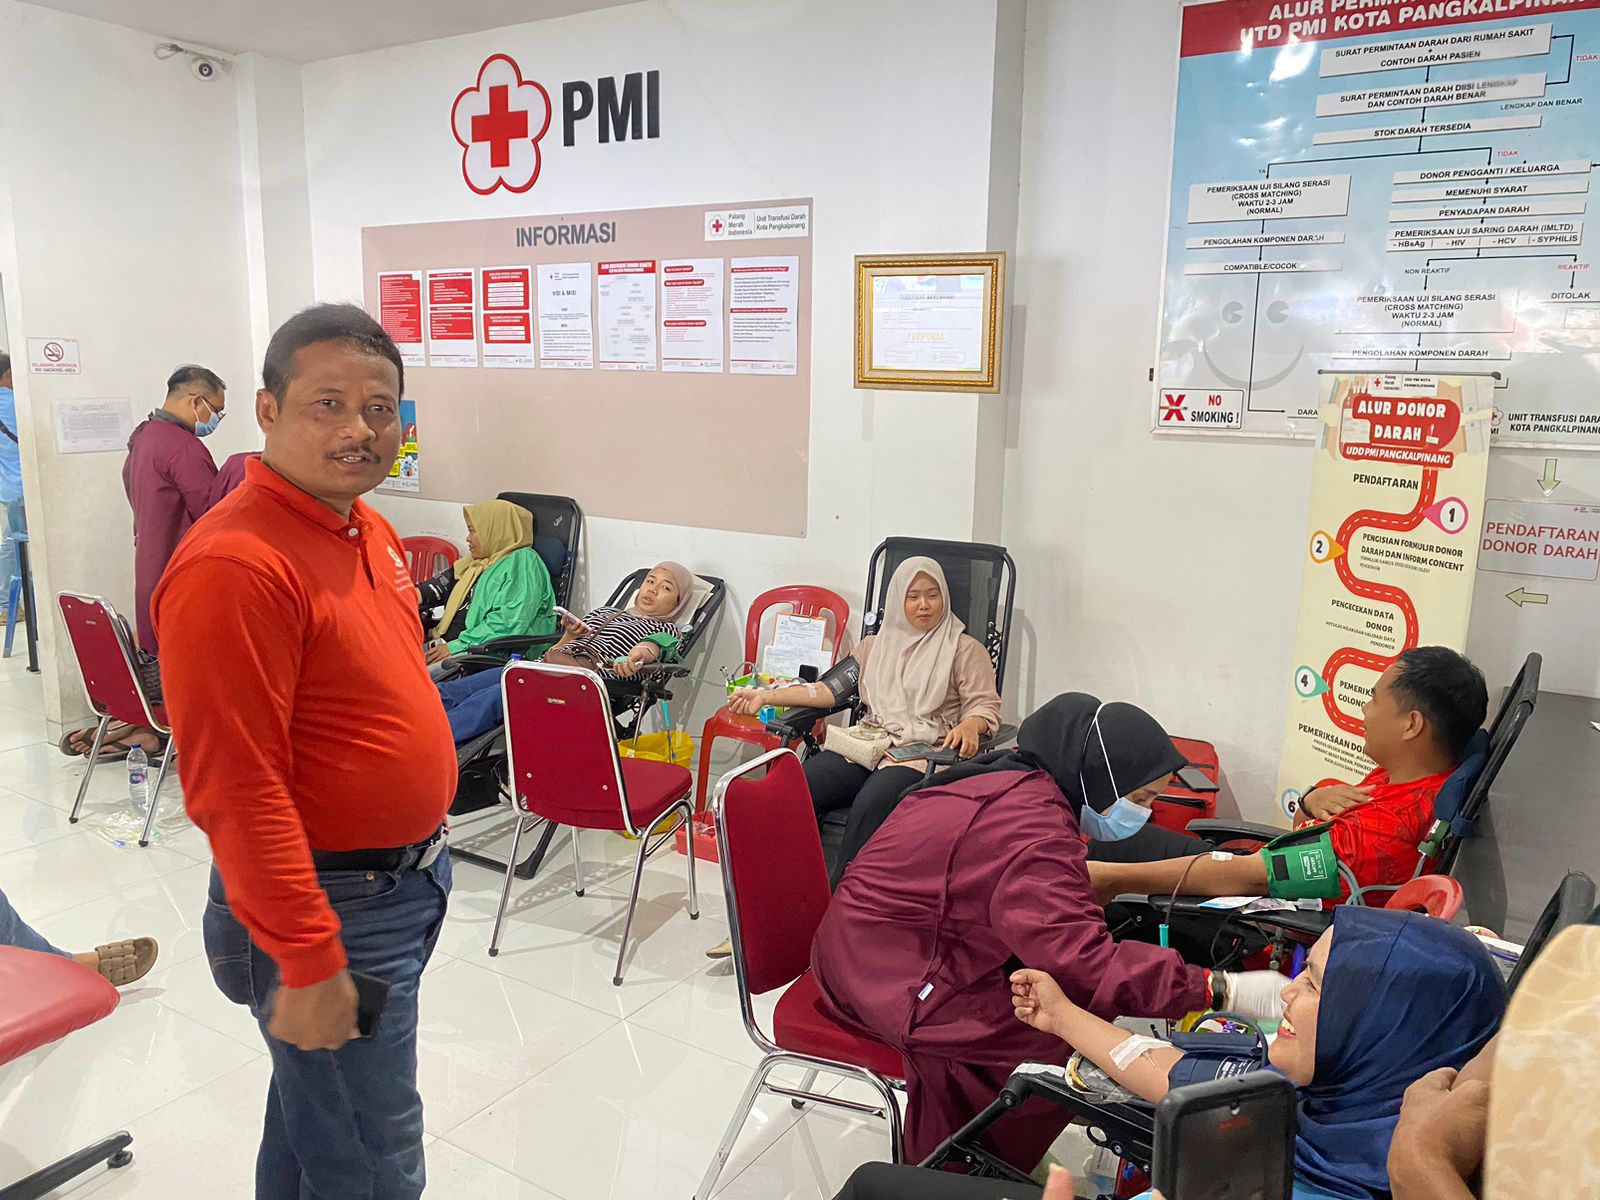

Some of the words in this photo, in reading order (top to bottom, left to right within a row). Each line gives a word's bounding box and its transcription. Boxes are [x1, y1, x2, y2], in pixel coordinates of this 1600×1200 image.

[1269, 0, 1324, 21] ALUR
[1288, 18, 1327, 38] PMI
[1334, 10, 1391, 31] KOTA
[1335, 48, 1362, 57] SURAT
[1363, 42, 1416, 55] PERMINTAAN
[1418, 38, 1449, 48] DARAH
[1450, 36, 1472, 45] DARI
[1473, 32, 1506, 42] RUMAH
[1507, 28, 1535, 38] SAKIT
[1380, 57, 1415, 67] CONTOH
[1417, 53, 1448, 63] DARAH
[1449, 50, 1481, 60] PASIEN
[1575, 54, 1598, 62] TIDAK
[1340, 94, 1366, 103] SURAT
[1368, 88, 1421, 100] PERMINTAAN
[1423, 85, 1453, 94] DARAH
[1367, 101, 1385, 109] DAN
[1386, 98, 1421, 107] CONTOH
[1423, 95, 1454, 104] DARAH
[1455, 91, 1486, 100] BENAR
[562, 70, 660, 147] PMI
[1500, 102, 1536, 111] LENGKAP
[1537, 100, 1554, 108] DAN
[1555, 98, 1583, 106] BENAR
[1374, 129, 1396, 137] STOK
[1397, 126, 1428, 135] DARAH
[1430, 123, 1471, 132] TERSEDIA
[1420, 171, 1451, 180] DONOR
[1452, 168, 1503, 178] PENGGANTI
[1510, 164, 1560, 174] KELUARGA
[1206, 184, 1259, 194] PEMERIKSAAN
[1259, 183, 1272, 191] UJI
[1272, 181, 1301, 190] SILANG
[1302, 179, 1331, 188] SERASI
[1445, 187, 1491, 196] MEMENUHI
[1493, 185, 1528, 194] SYARAT
[1231, 192, 1259, 201] (CROSS
[1260, 189, 1302, 198] MATCHING)
[1237, 199, 1264, 207] WAKTU
[1265, 198, 1277, 206] 2-3
[728, 213, 745, 221] Palang
[756, 214, 767, 222] Unit
[767, 213, 790, 221] Transfusi
[1246, 207, 1283, 216] (NORMAL)
[1438, 207, 1496, 217] PENYADAPAN
[1498, 206, 1530, 214] DARAH
[769, 222, 805, 231] Pangkalpinang
[1395, 227, 1455, 238] PEMERIKSAAN
[1456, 226, 1470, 235] UJI
[1472, 225, 1505, 234] SARING
[1506, 224, 1539, 232] DARAH
[1540, 223, 1574, 232] (IMLTD)
[516, 221, 617, 248] INFORMASI
[1203, 237, 1252, 246] PENGOLAHAN
[1253, 235, 1297, 244] KOMPONEN
[1497, 237, 1516, 245] HCV
[1537, 235, 1578, 243] SYPHILIS
[1223, 262, 1297, 271] COMPATIBLE/COCOK
[1356, 294, 1415, 303] PEMERIKSAAN
[1416, 294, 1430, 302] UJI
[1431, 293, 1462, 302] SILANG
[1464, 293, 1496, 301] SERASI
[1551, 292, 1591, 300] DITOLAK
[1384, 303, 1416, 312] (CROSS
[1417, 302, 1464, 311] MATCHING)
[1391, 311, 1421, 319] WAKTU
[1422, 311, 1435, 319] 2-3
[1436, 311, 1454, 319] JAM
[1401, 319, 1442, 328] (NORMAL)
[1352, 349, 1407, 358] PENGOLAHAN
[1409, 349, 1456, 357] KOMPONEN
[1457, 349, 1488, 357] DARAH
[1208, 395, 1222, 406] NO
[1357, 400, 1392, 415] ALUR
[1396, 402, 1447, 418] DONOR
[1191, 411, 1233, 423] SMOKING
[1508, 413, 1528, 421] UNIT
[1530, 413, 1577, 423] TRANSFUSI
[1374, 424, 1422, 441] DARAH
[1510, 423, 1531, 432] KOTA
[1345, 446, 1364, 455] UDD
[1364, 447, 1379, 457] PMI
[1379, 449, 1451, 464] PANGKALPINANG
[1353, 473, 1419, 490] PENDAFTARAN
[1449, 507, 1456, 523] 1
[1486, 522, 1599, 542] PENDAFTARAN
[1315, 540, 1323, 553] 2
[1400, 538, 1434, 553] FORMULIR
[1435, 545, 1463, 558] DONOR
[1482, 539, 1537, 555] DONOR
[1543, 544, 1598, 560] DARAH
[1361, 545, 1385, 557] DARAH
[1385, 550, 1401, 560] DAN
[1402, 552, 1428, 566] INFORM
[1428, 557, 1464, 572] CONCENT
[1374, 609, 1394, 620] DATA
[1365, 621, 1393, 633] DONOR
[1300, 674, 1309, 688] 4
[1298, 723, 1350, 749] PEMERIKSAAN
[1351, 743, 1365, 755] DO
[1287, 800, 1296, 813] 6
